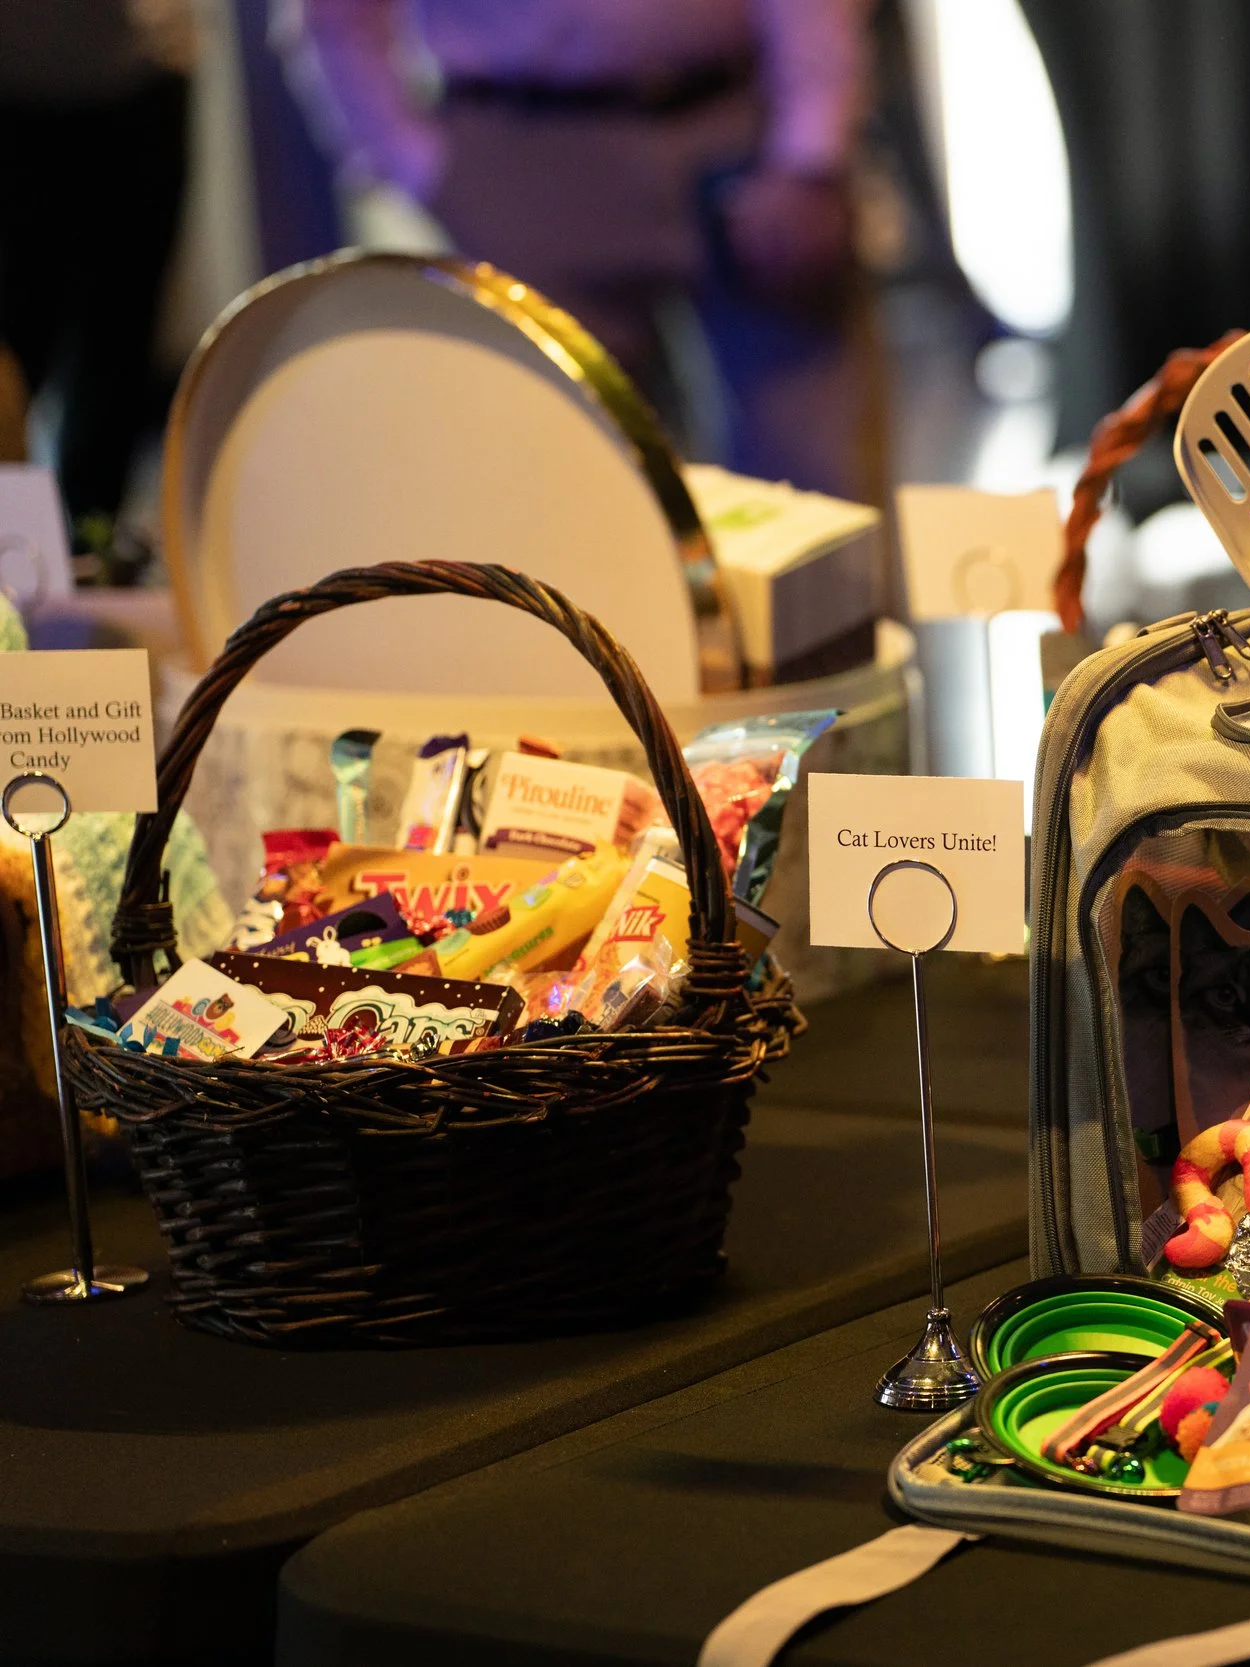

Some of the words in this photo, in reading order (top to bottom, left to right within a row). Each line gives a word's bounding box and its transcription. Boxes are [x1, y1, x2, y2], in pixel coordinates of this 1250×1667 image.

[1, 701, 60, 720] Basket
[66, 701, 99, 719] and
[105, 700, 141, 719] Gift
[0, 729, 31, 745] om
[38, 724, 140, 748] Hollywood
[10, 749, 70, 773] Candy
[837, 828, 868, 848] Cat
[873, 830, 936, 850] Lovers
[942, 832, 997, 852] Unite!
[1213, 1275, 1237, 1293] the
